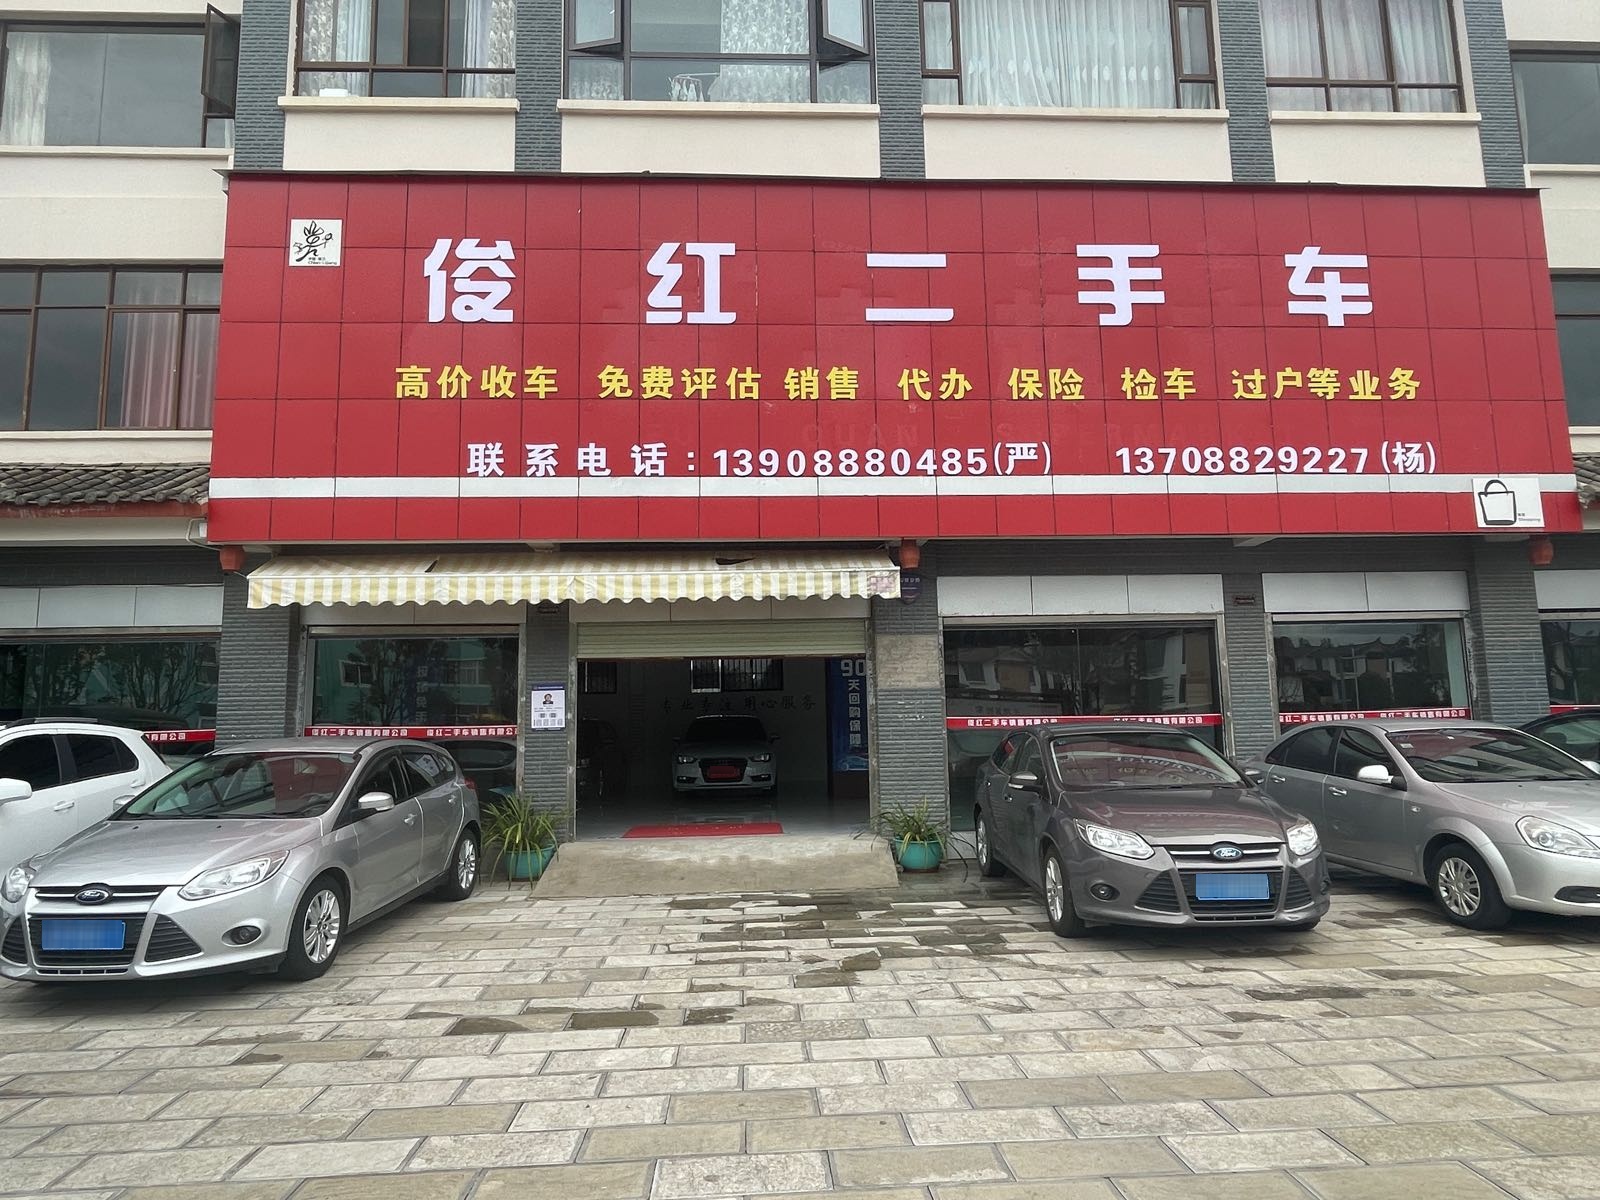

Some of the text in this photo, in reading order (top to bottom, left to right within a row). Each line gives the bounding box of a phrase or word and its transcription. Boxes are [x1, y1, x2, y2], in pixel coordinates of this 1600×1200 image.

[424, 239, 1373, 327] 俊红二手车
[396, 365, 1420, 401] 高价收车 免费评估 销售 代办 保险 检车 过户等业务
